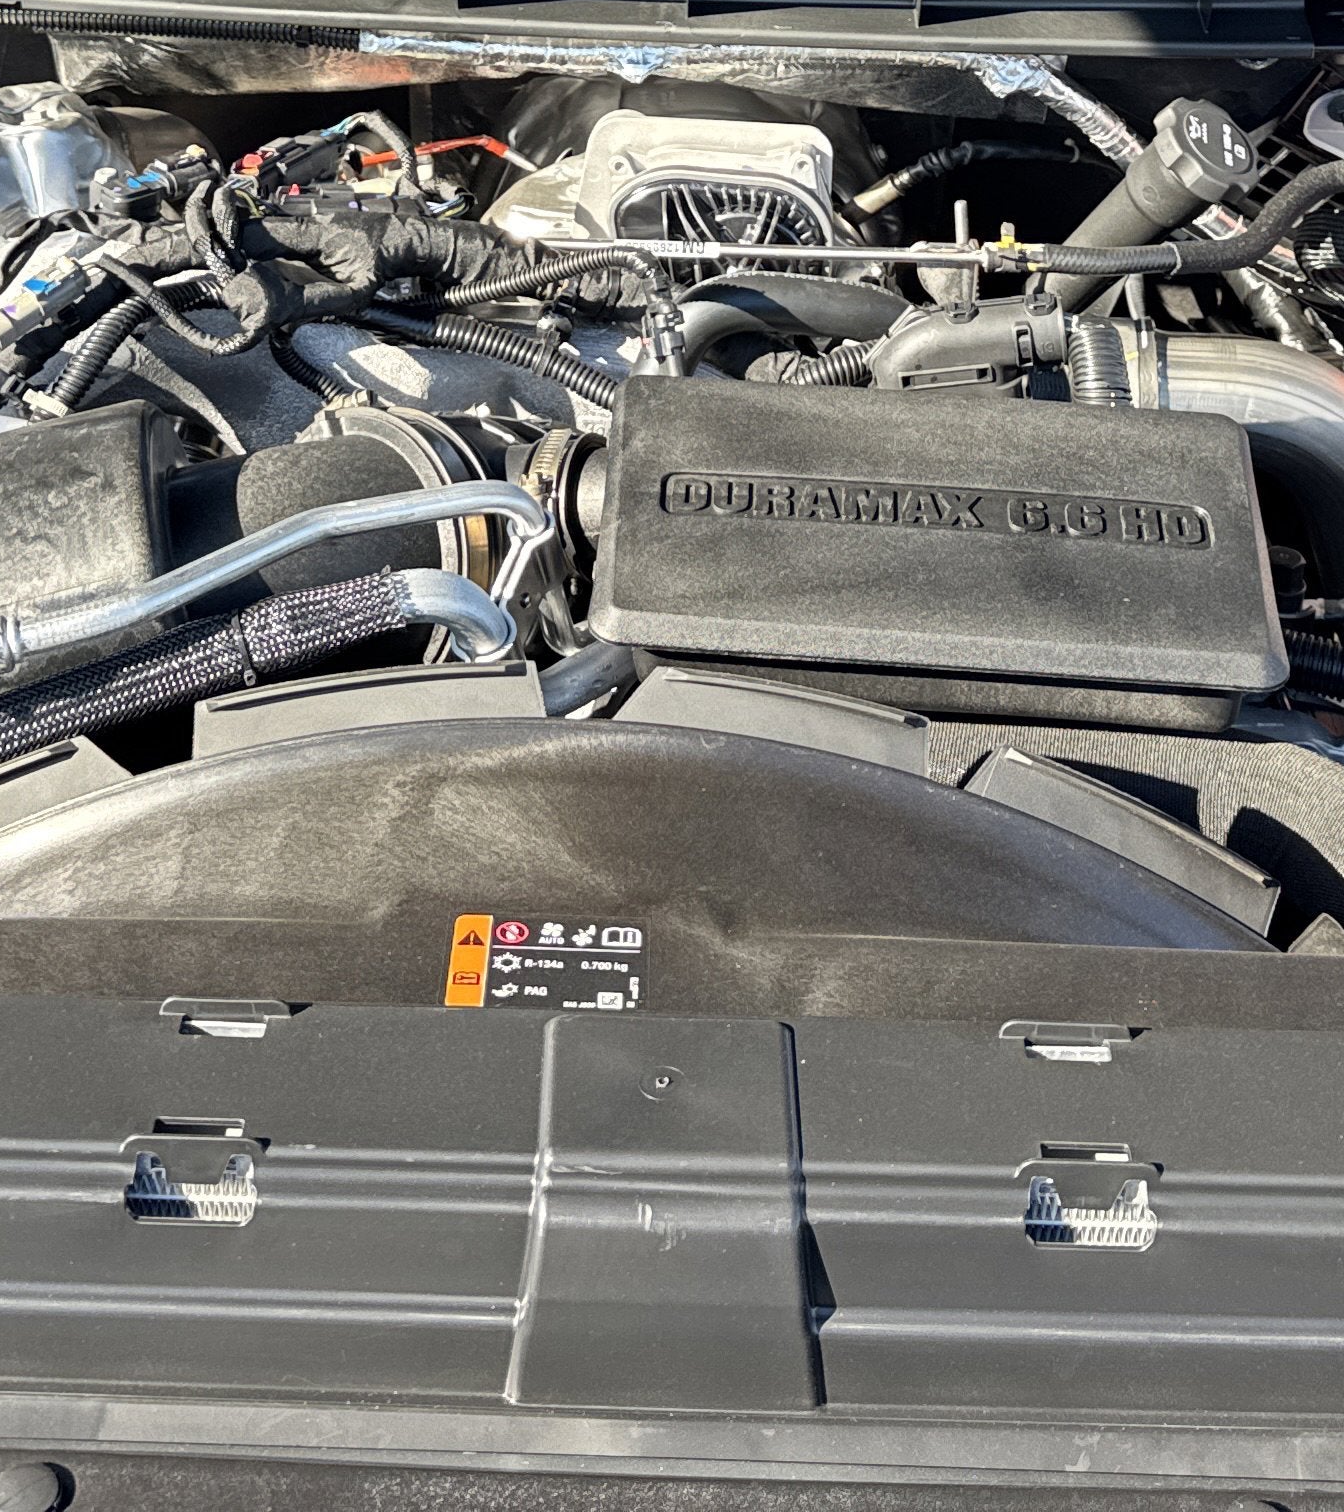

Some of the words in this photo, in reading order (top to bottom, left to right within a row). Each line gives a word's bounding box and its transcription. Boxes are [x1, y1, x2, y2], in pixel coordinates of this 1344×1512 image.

[666, 476, 985, 529] DURAMAX
[1007, 498, 1107, 537] 6.6
[1120, 504, 1214, 548] HD
[538, 936, 565, 945] AUTO
[524, 958, 564, 969] R-134a
[581, 961, 612, 970] 0.700
[613, 962, 629, 973] kg
[524, 986, 548, 996] PAG
